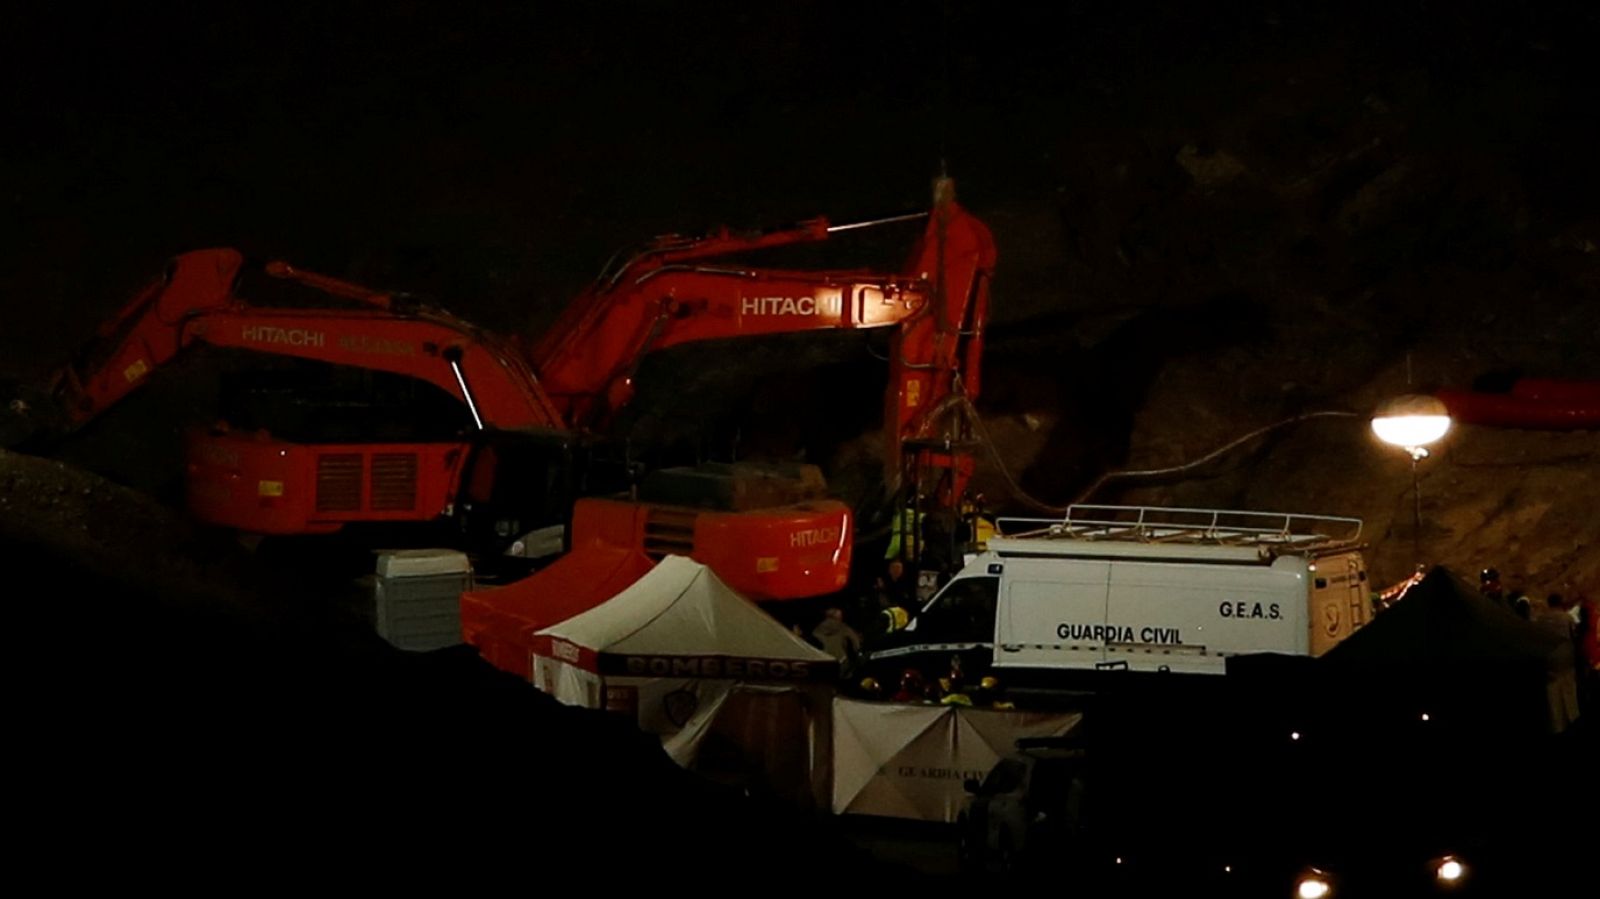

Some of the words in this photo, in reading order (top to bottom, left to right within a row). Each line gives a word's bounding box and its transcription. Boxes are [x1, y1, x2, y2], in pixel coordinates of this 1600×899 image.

[241, 324, 326, 348] HITACHI
[790, 526, 841, 547] HITACH
[1220, 601, 1283, 620] G.E.A.S.
[1057, 623, 1134, 642] GUARDIA
[1141, 627, 1183, 644] CIVIL
[626, 656, 809, 681] BOMBEROS
